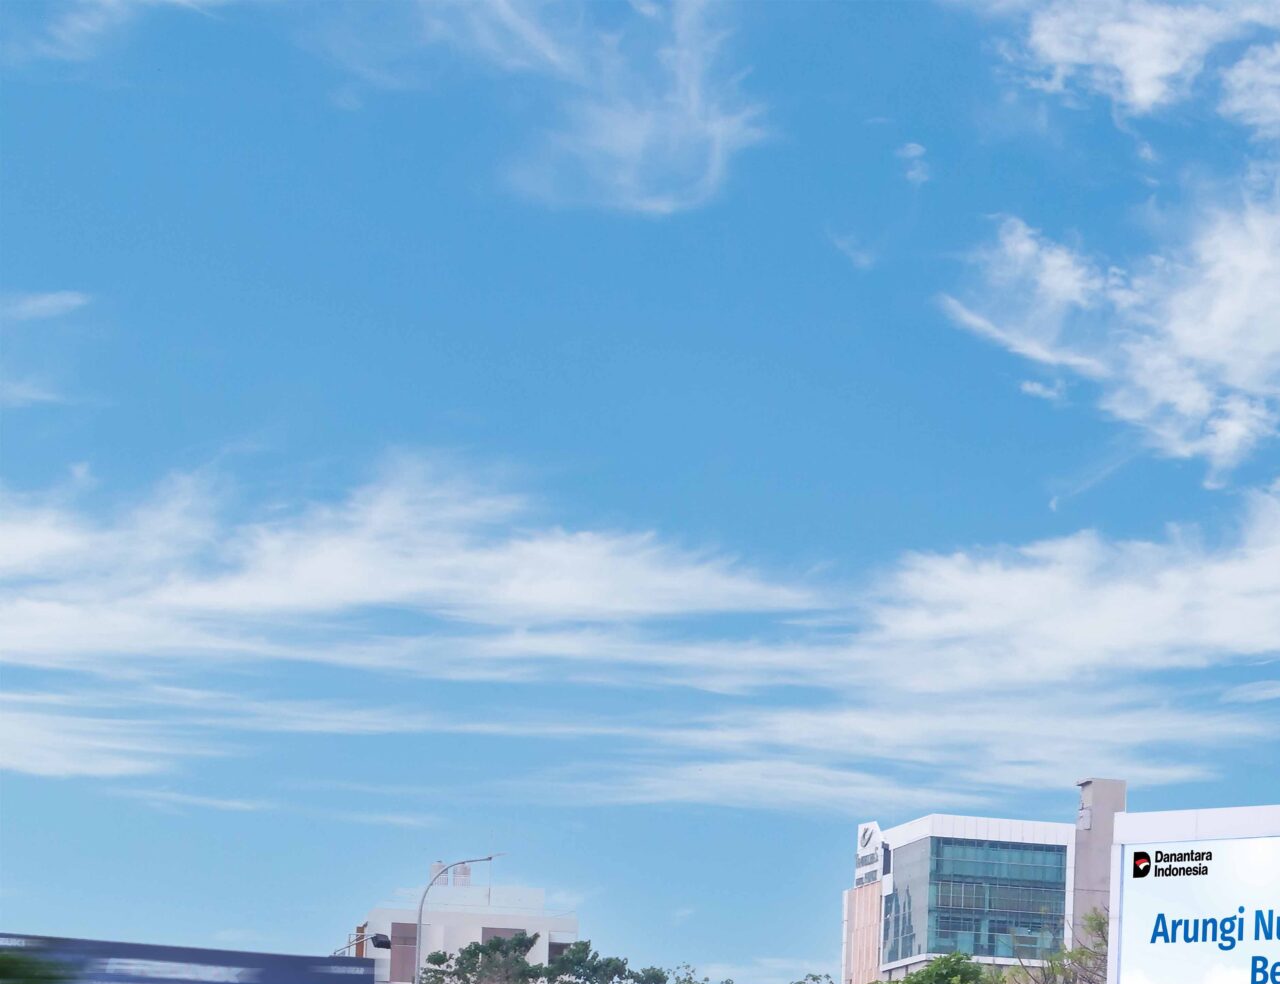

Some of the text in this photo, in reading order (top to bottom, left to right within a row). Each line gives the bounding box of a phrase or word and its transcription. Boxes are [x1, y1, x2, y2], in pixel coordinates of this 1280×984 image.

[1154, 850, 1213, 863] Danantara
[1154, 863, 1208, 877] Indonesia
[1150, 906, 1245, 951] Arungi
